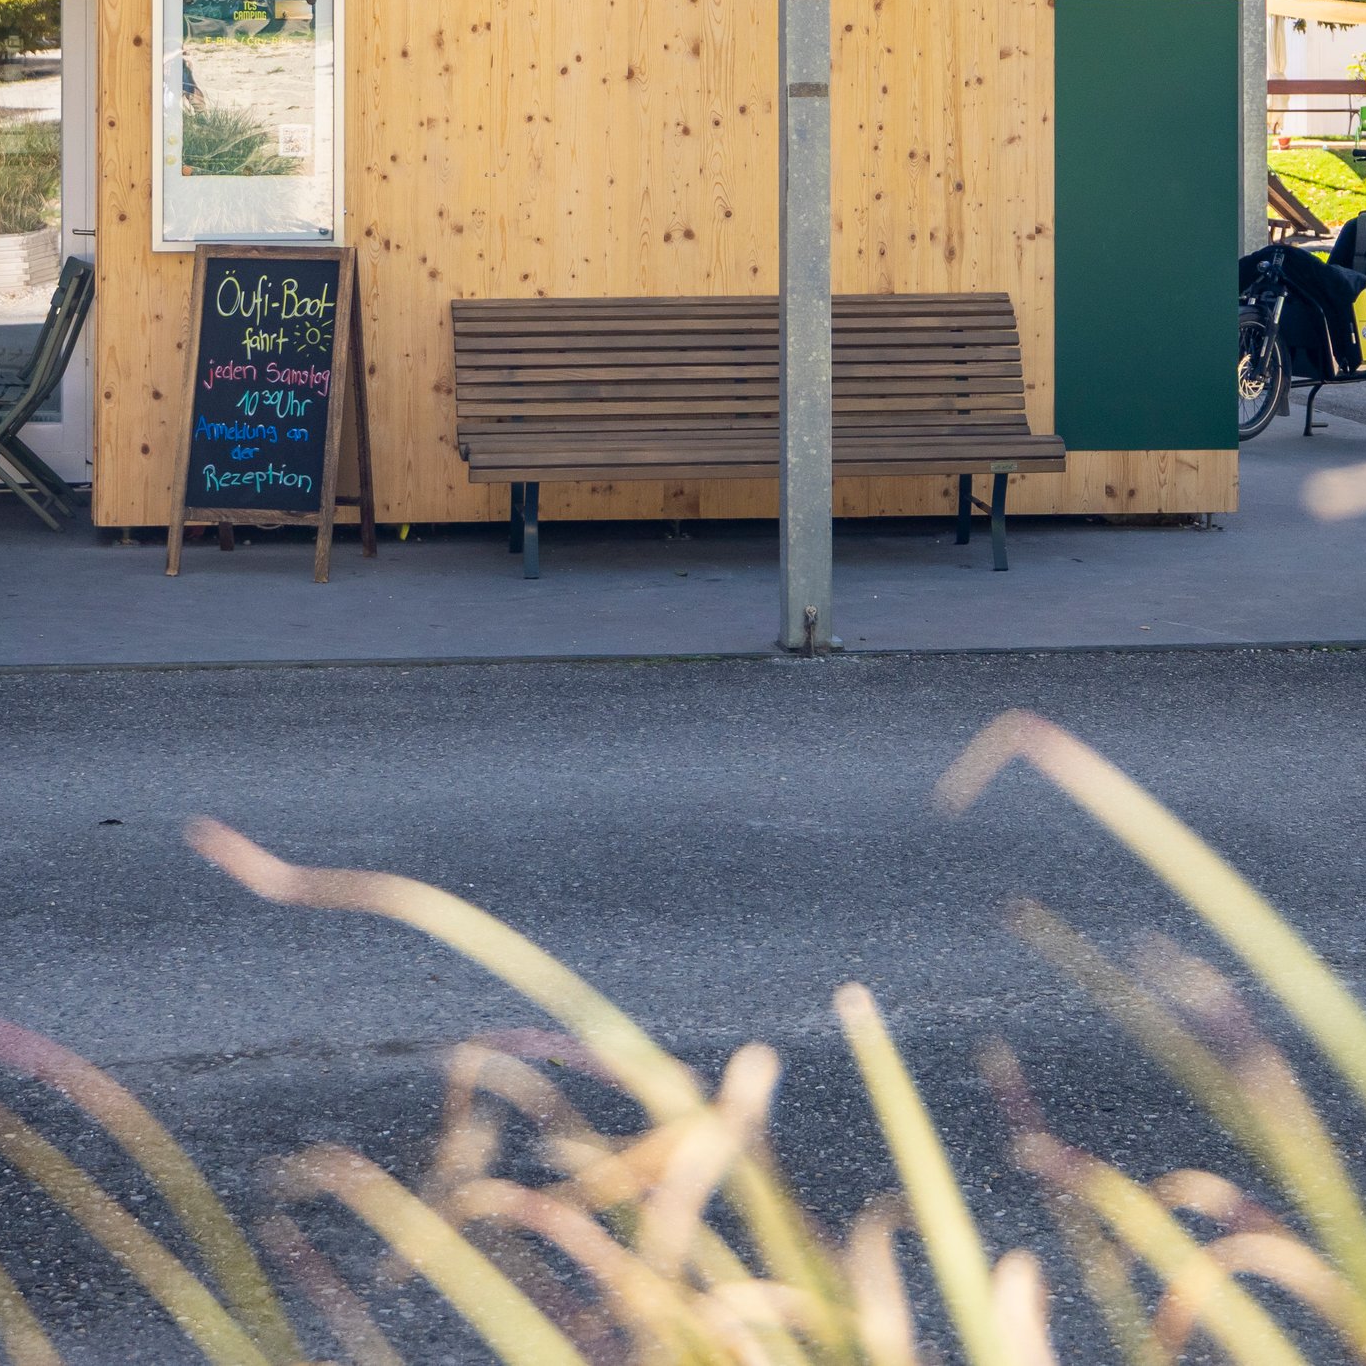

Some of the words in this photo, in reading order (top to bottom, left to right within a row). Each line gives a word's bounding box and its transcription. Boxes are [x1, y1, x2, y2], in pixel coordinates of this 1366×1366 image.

[233, 10, 267, 21] CAMPING
[243, 0, 258, 11] TCS
[217, 269, 335, 326] Öufi-Boot
[241, 327, 290, 361] fahrt
[203, 358, 257, 390] jeden
[266, 362, 331, 398] Samstag
[286, 428, 309, 442] an
[230, 444, 260, 461] der
[202, 463, 313, 493] Rezeption
